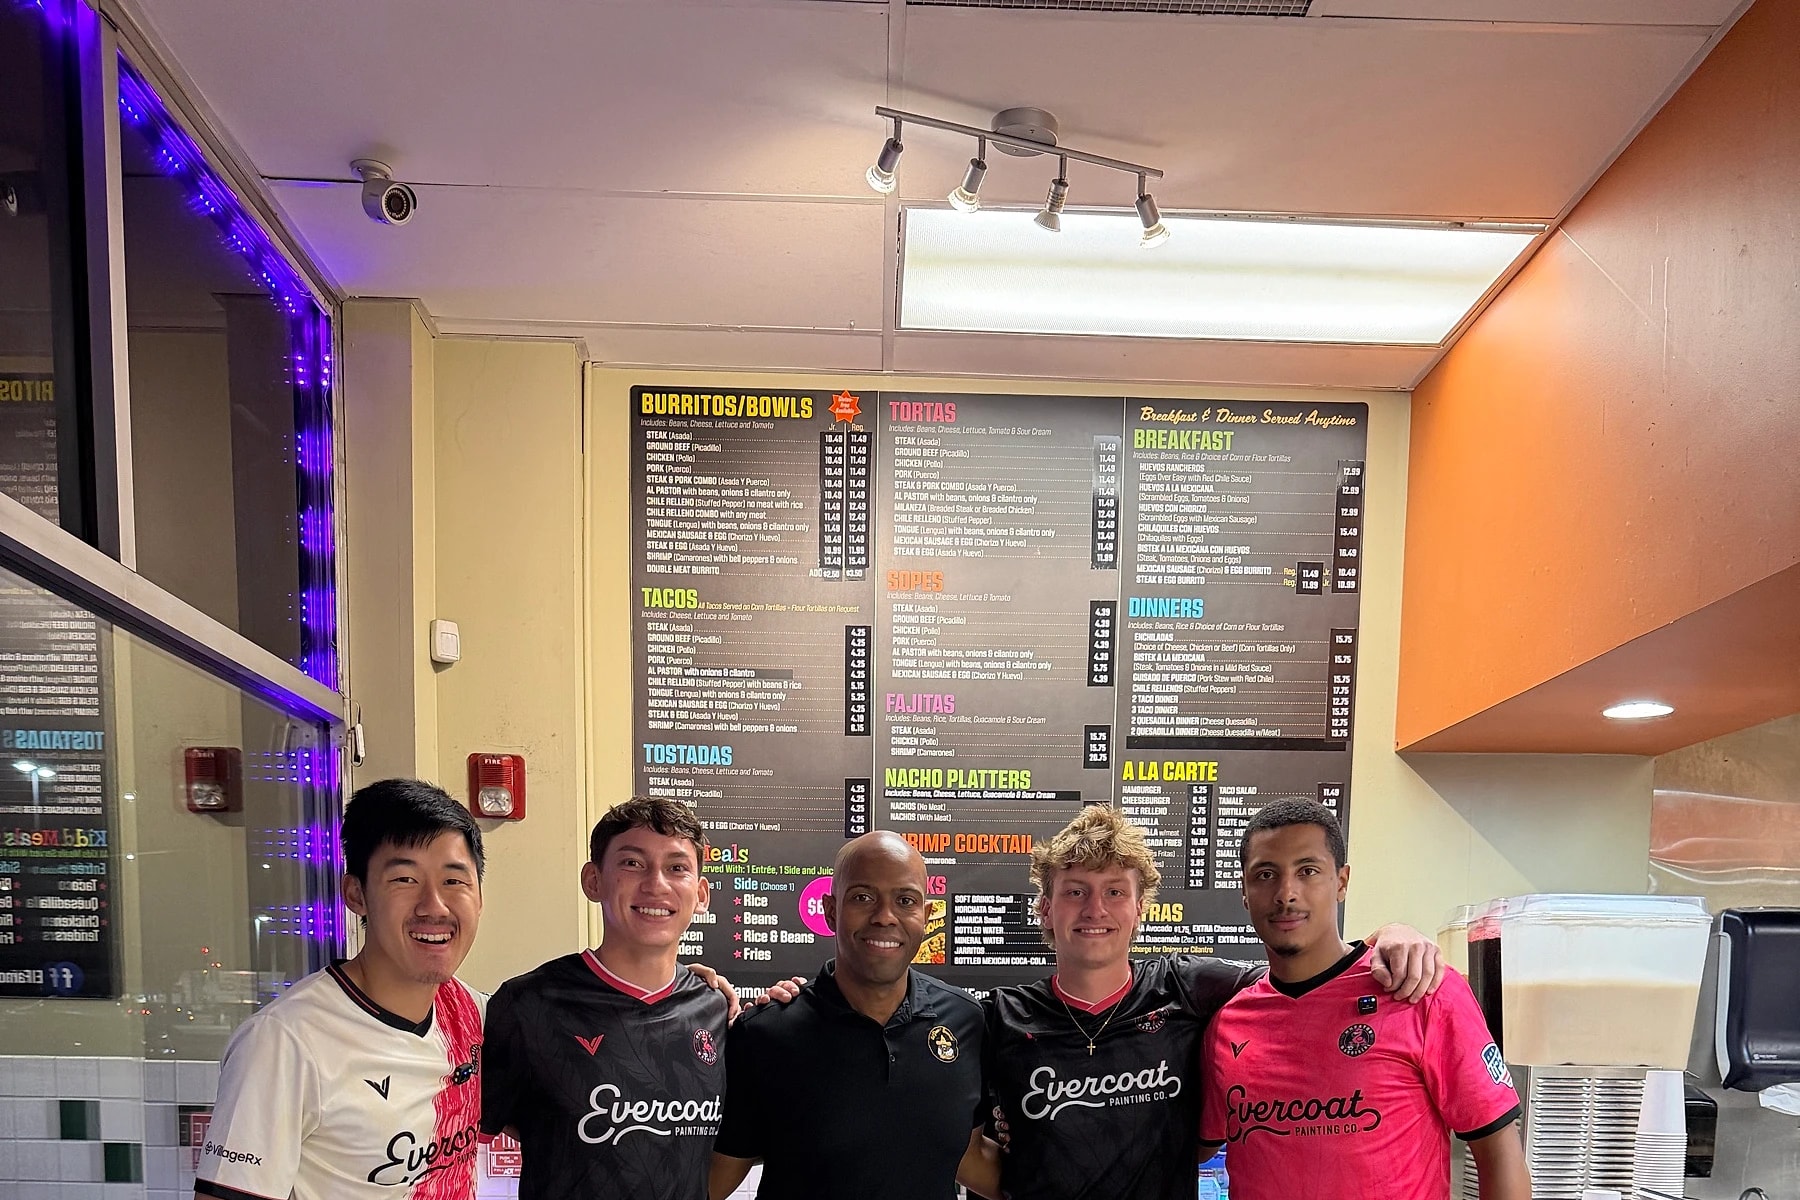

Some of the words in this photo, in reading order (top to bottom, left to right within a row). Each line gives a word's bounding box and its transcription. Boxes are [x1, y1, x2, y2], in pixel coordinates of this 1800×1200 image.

[641, 393, 813, 419] BURRITOS/BOWLS
[889, 402, 956, 422] TORTAS
[1141, 406, 1197, 424] Breakfast
[1202, 407, 1211, 422] &
[1216, 408, 1257, 424] Dinner
[1261, 409, 1301, 425] Served
[1304, 410, 1356, 429] Anytime
[669, 420, 688, 429] Beans,
[690, 421, 713, 429] Cheese,
[715, 421, 737, 429] Lettuce
[917, 425, 936, 433] Beans,
[938, 426, 961, 434] Cheese,
[962, 427, 987, 435] Lettuce,
[647, 431, 667, 439] STEAK
[669, 432, 692, 441] (Asada)
[1133, 429, 1234, 450] BREAKFAST
[647, 443, 673, 451] GROUND
[674, 443, 690, 451] BEEF
[692, 443, 721, 452] (Picadillo)
[1100, 443, 1116, 451] 11.49
[647, 454, 674, 462] CHICKEN
[895, 459, 922, 467] CHICKEN
[924, 460, 943, 468] (Pollo)
[1140, 463, 1165, 472] HUEVOS
[1166, 464, 1204, 472] RANCHEROS
[647, 476, 667, 484] STEAK
[669, 476, 673, 484] &
[675, 476, 692, 484] PORK
[694, 477, 717, 485] COMBO
[718, 478, 739, 486] (Asada
[746, 478, 769, 487] Puerco)
[647, 487, 654, 495] AL
[655, 487, 681, 495] PASTOR
[682, 488, 697, 496] with
[698, 488, 720, 497] beans,
[722, 489, 743, 497] onions
[745, 489, 749, 497] &
[750, 489, 775, 497] cilantro
[777, 490, 790, 499] only
[647, 565, 672, 573] DOUBLE
[673, 565, 690, 574] MEAT
[692, 566, 720, 574] BURRITO
[887, 570, 944, 592] SOPES
[642, 588, 698, 608] TACOS
[1128, 597, 1203, 619] DINNERS
[1152, 685, 1183, 693] RELLENOS
[1184, 685, 1208, 694] (Stuffed
[1209, 686, 1236, 695] Peppers)
[886, 693, 955, 714] FAJITAS
[675, 722, 713, 731] (Camarones)
[714, 723, 729, 731] with
[730, 723, 741, 731] bell
[742, 724, 769, 733] peppers
[770, 724, 775, 732] &
[891, 726, 912, 734] STEAK
[913, 727, 936, 735] (Asada)
[891, 737, 918, 745] CHICKEN
[920, 738, 938, 746] (Pollo)
[1090, 733, 1106, 741] 15.75
[644, 744, 733, 766] TOSTADAS
[891, 748, 916, 756] SHRIMP
[917, 748, 954, 757] (Camarones)
[1122, 761, 1134, 781] A
[1138, 761, 1159, 781] LA
[1163, 761, 1218, 782] CARTE
[649, 777, 669, 785] STEAK
[671, 778, 694, 787] (Asada)
[885, 768, 942, 788] NACHO
[946, 769, 1031, 790] PLATTERS
[851, 785, 865, 793] 4.25
[1219, 797, 1243, 805] TAMALE
[891, 802, 916, 811] NACHOS
[917, 803, 927, 811] (No
[929, 803, 945, 812] Meat)
[891, 813, 916, 821] NACHOS
[917, 814, 933, 822] (With
[934, 814, 951, 823] Meat)
[955, 834, 1032, 854] COCKTAIL
[702, 865, 724, 873] erved
[726, 865, 745, 874] With:
[752, 865, 777, 875] Entrée,
[780, 866, 783, 874] 1
[784, 866, 800, 874] Side
[801, 867, 816, 875] and
[817, 867, 833, 875] Juic
[734, 877, 758, 890] Side
[761, 882, 787, 891] (Choose
[788, 883, 795, 891] 1)
[744, 894, 768, 907] Rice
[955, 906, 987, 914] HORCHATA
[744, 912, 778, 925] Beans
[954, 916, 982, 924] JAMAICA
[744, 930, 768, 943] Rice
[770, 931, 778, 943] &
[780, 931, 814, 944] Beans
[744, 948, 771, 961] Fries
[954, 957, 981, 965] BOTTLED
[982, 957, 1009, 965] MEXICAN
[1011, 957, 1046, 965] COCA-COLA
[1021, 1060, 1182, 1120] Evercoat
[1109, 1094, 1151, 1107] PAINTING
[1154, 1092, 1167, 1100] CO.
[578, 1084, 722, 1145] Evercoat
[1226, 1085, 1382, 1144] Evercoat
[675, 1127, 708, 1136] PAINTING
[1295, 1125, 1340, 1136] PAINTING
[1344, 1124, 1361, 1133] CO.
